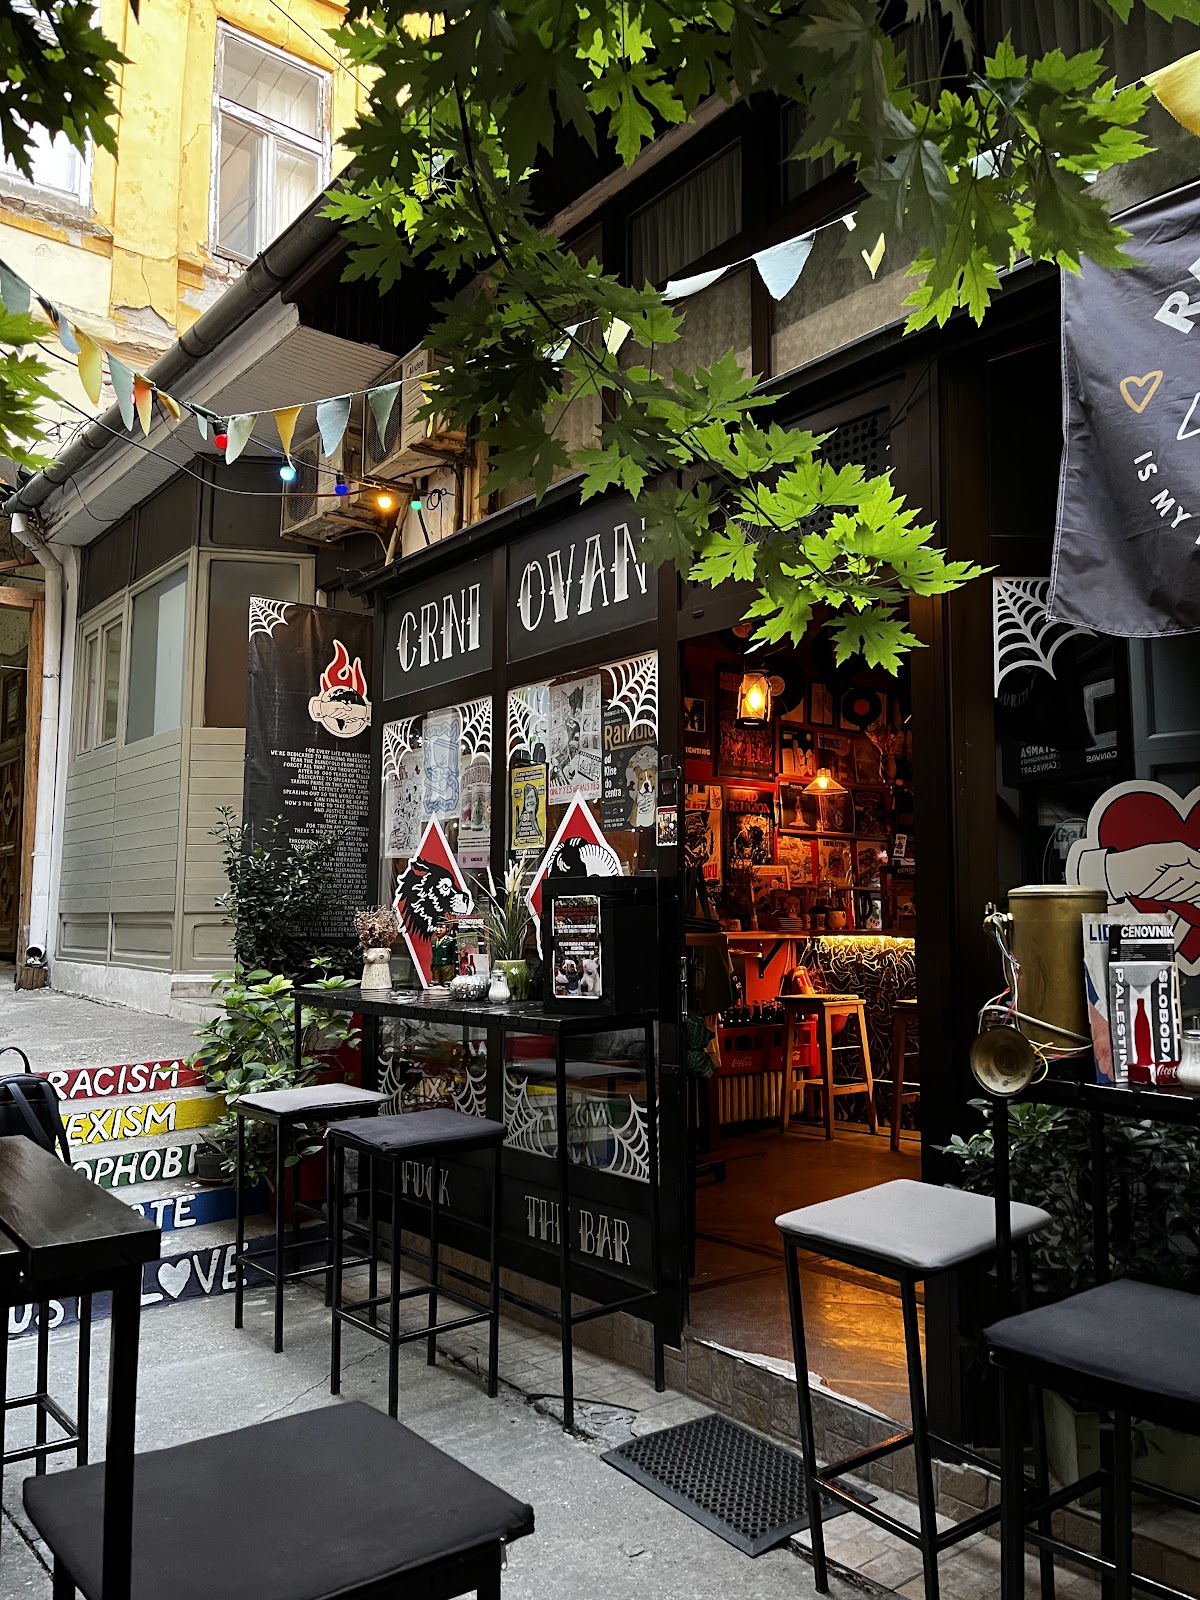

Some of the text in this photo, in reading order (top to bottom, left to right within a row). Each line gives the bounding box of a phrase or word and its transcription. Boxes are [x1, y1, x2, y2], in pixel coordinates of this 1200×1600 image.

[1133, 451, 1192, 529] IS MY
[396, 583, 480, 672] CRNI
[550, 787, 562, 795] ONLY
[563, 785, 572, 794] YES
[590, 781, 599, 791] YES
[604, 778, 612, 789] do
[604, 788, 622, 798] centra
[729, 800, 770, 813] RELIGION
[1120, 925, 1174, 938] CENOVNIK
[1115, 968, 1129, 1082] PALESTINI
[1158, 969, 1171, 1062] SLOBODA
[48, 1060, 179, 1100] RACISM
[56, 1102, 176, 1146] EXISM
[525, 1195, 631, 1266] TH BAR
